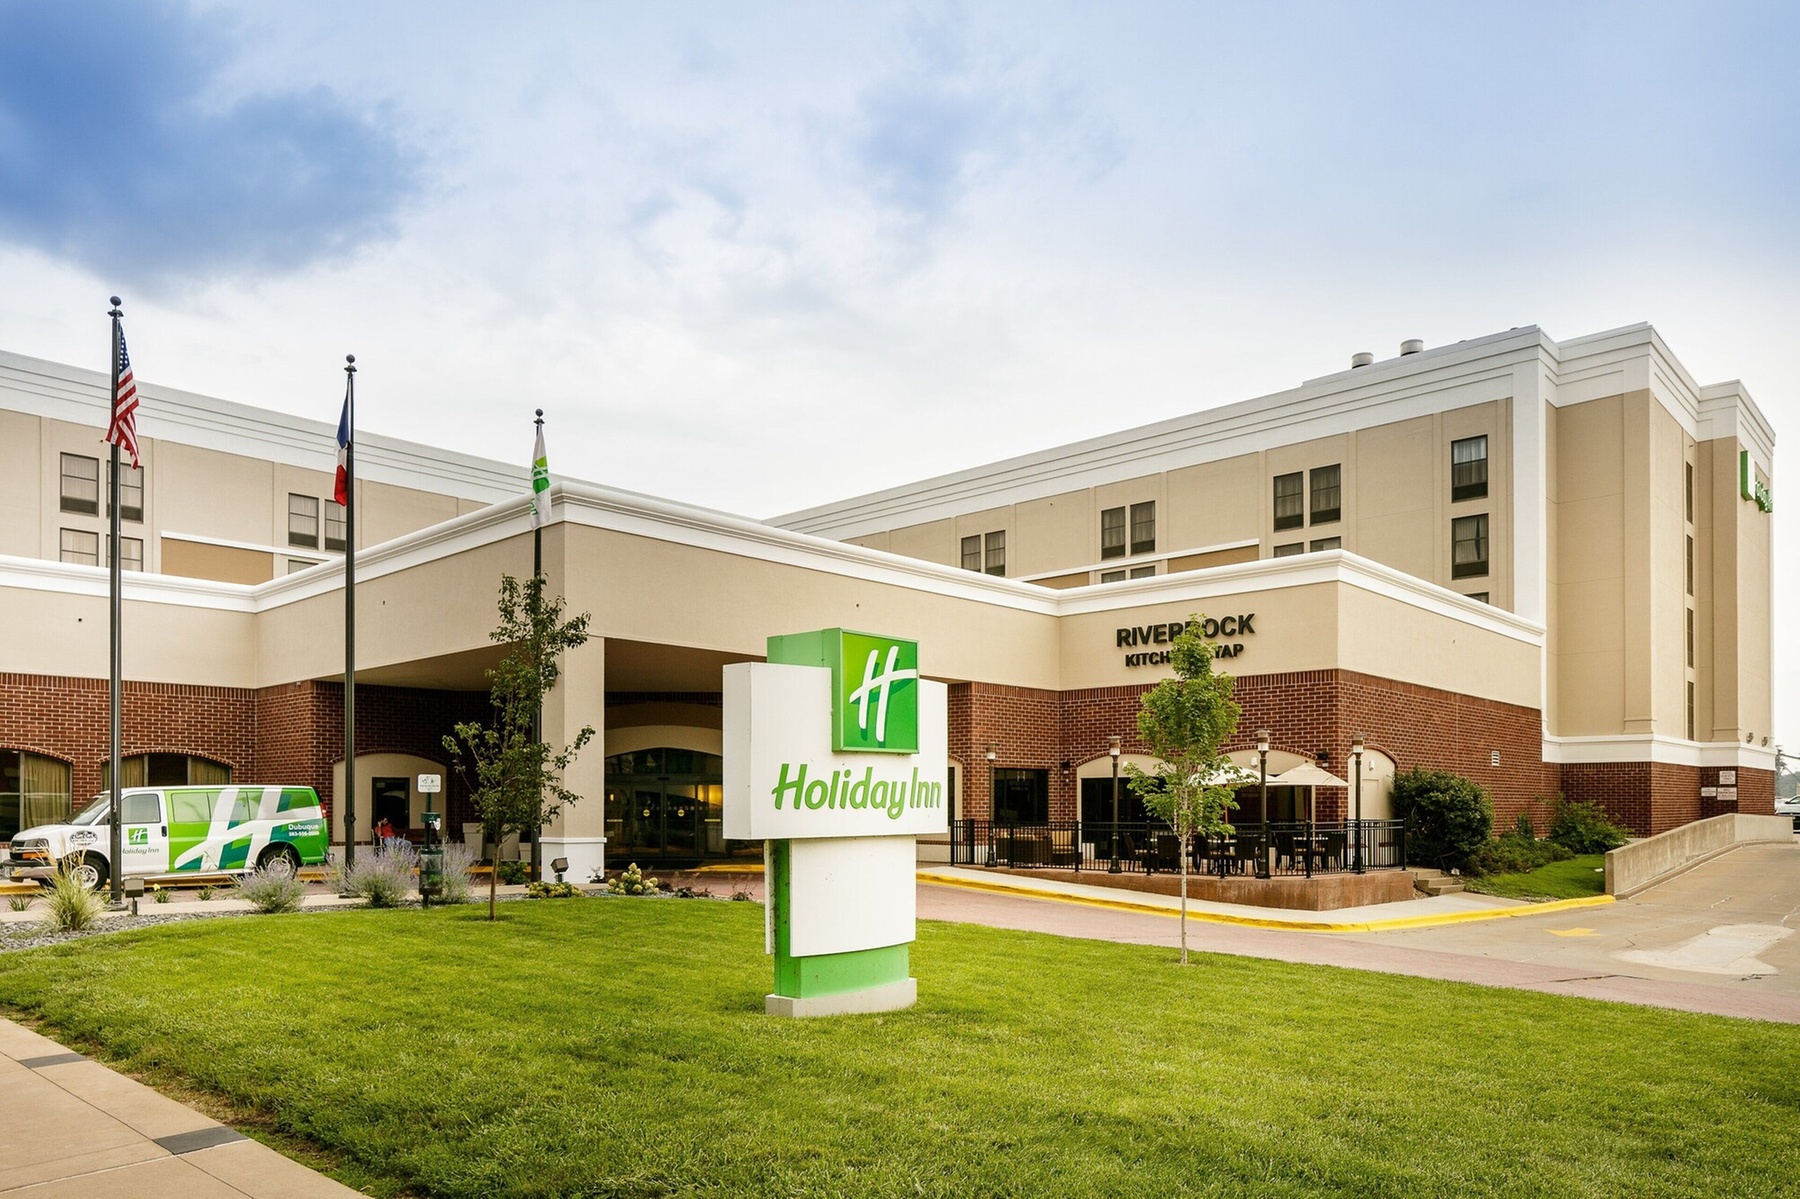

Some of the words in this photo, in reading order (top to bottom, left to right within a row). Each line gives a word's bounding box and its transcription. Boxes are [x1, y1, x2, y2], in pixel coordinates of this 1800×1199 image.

[771, 763, 907, 820] Holiday
[910, 766, 942, 809] Inn
[148, 846, 160, 854] Inn
